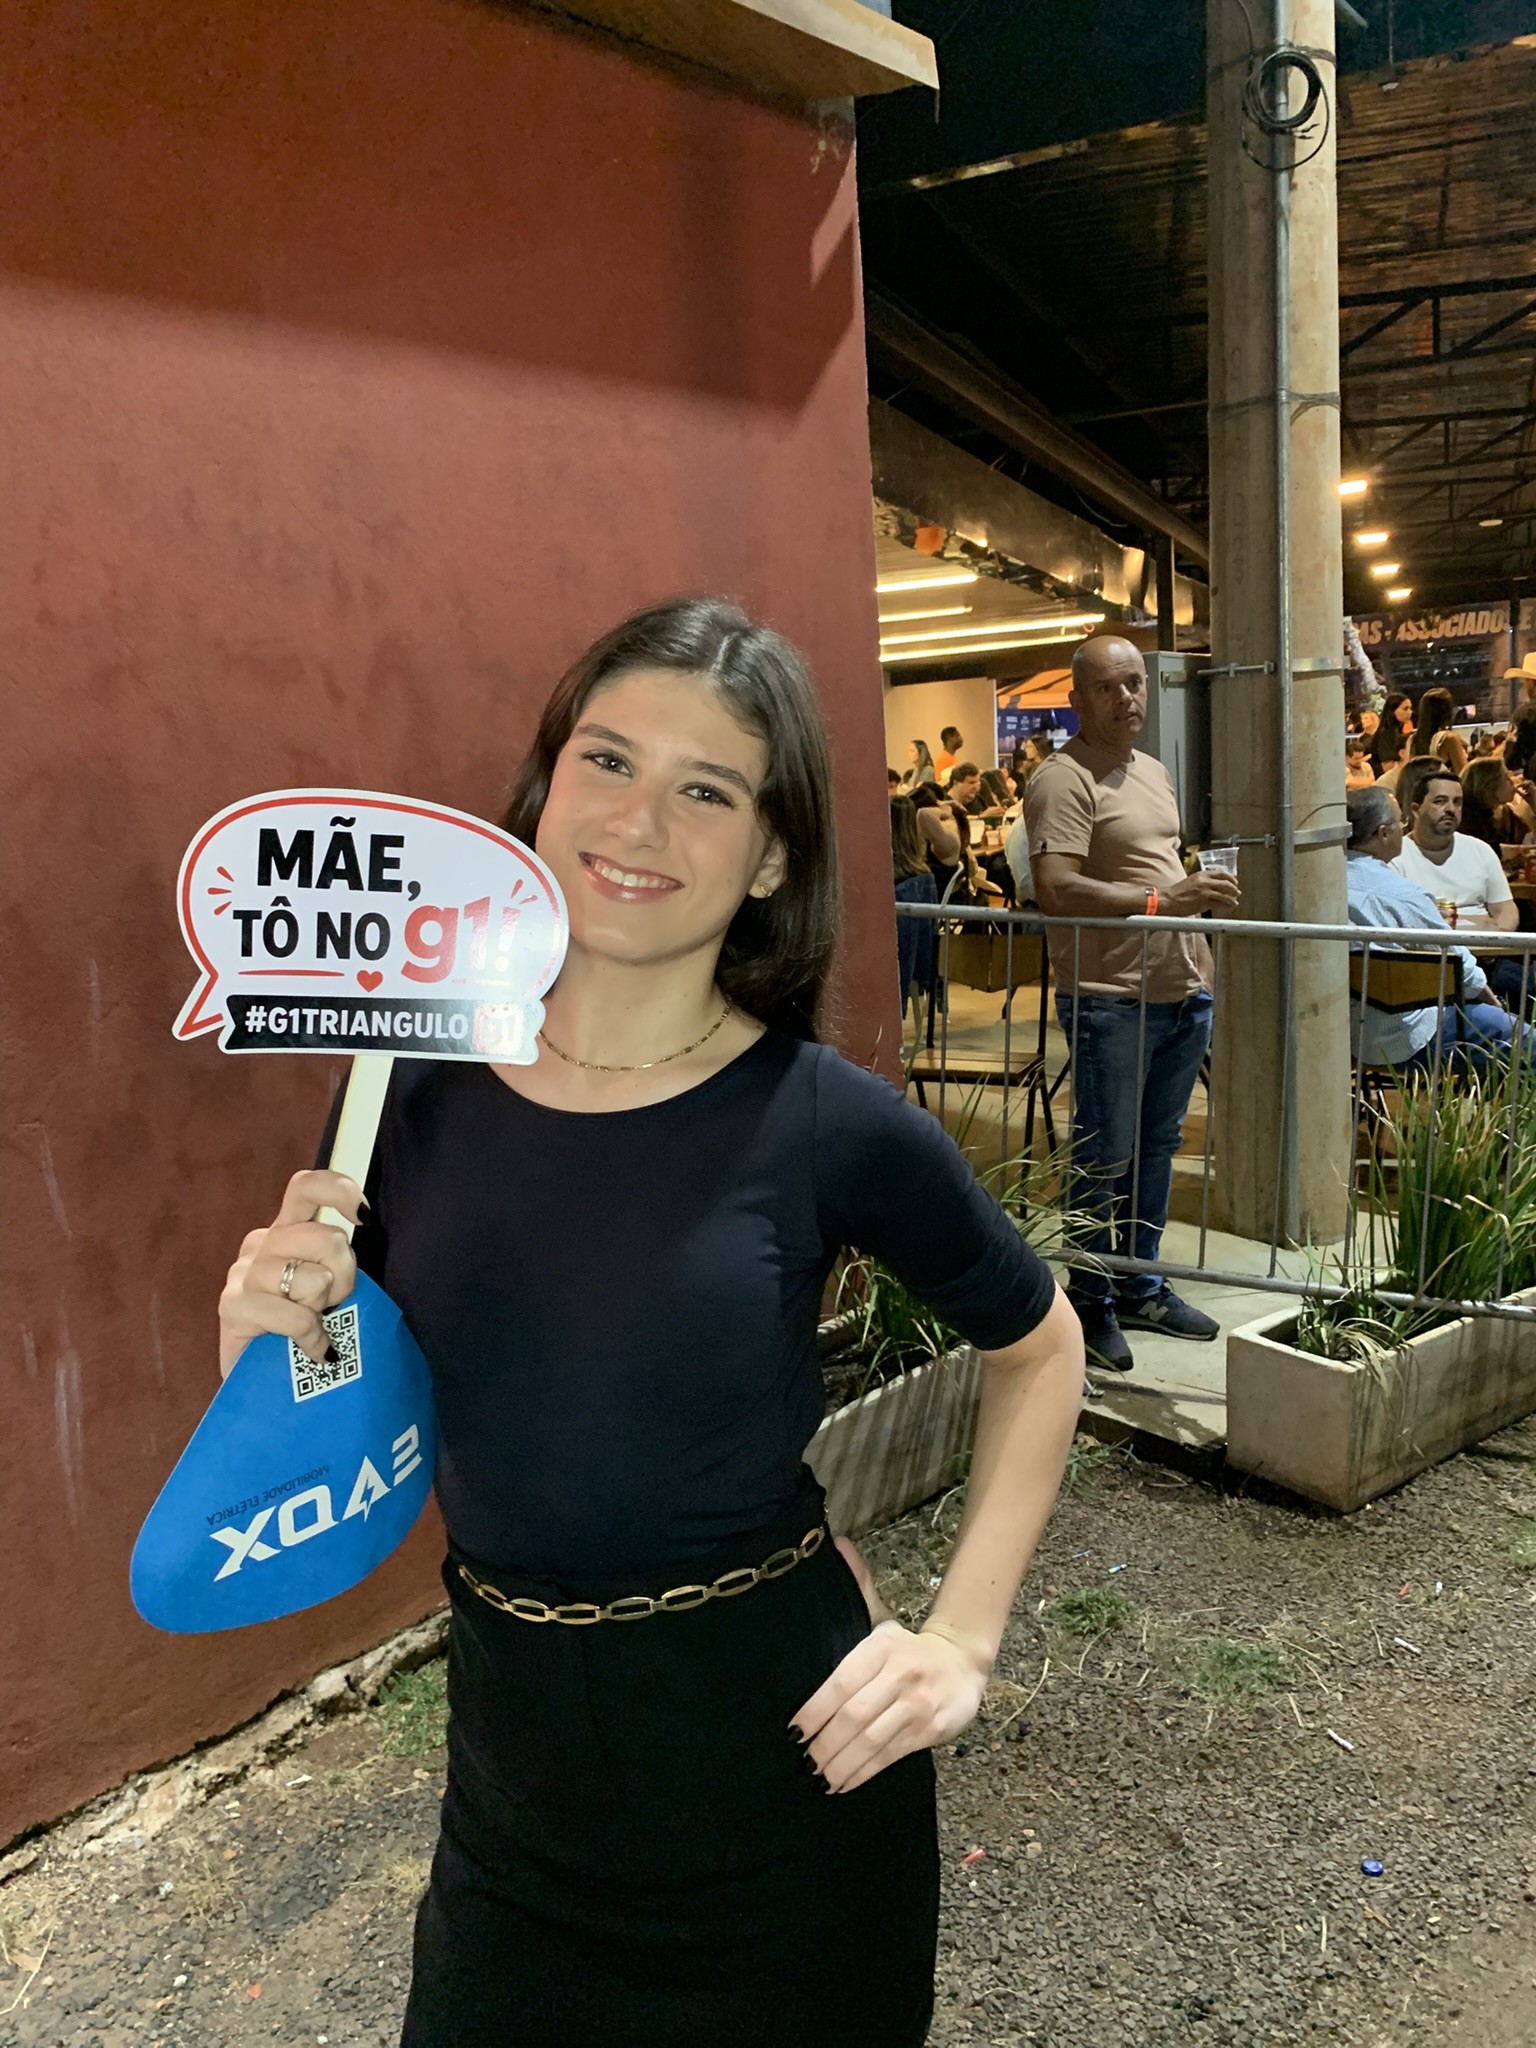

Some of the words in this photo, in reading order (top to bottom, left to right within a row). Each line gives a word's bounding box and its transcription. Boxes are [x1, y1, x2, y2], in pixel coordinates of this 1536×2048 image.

[256, 815, 422, 902] MÃE,
[232, 896, 299, 958] TÔ
[315, 911, 391, 962] NO
[400, 895, 522, 984] g1!
[244, 1004, 469, 1040] #G1TRIANGULO
[205, 1495, 260, 1527] ELÉTRICA
[208, 1423, 423, 1582] EVOX
[262, 1463, 330, 1503] MOBILIDADE
